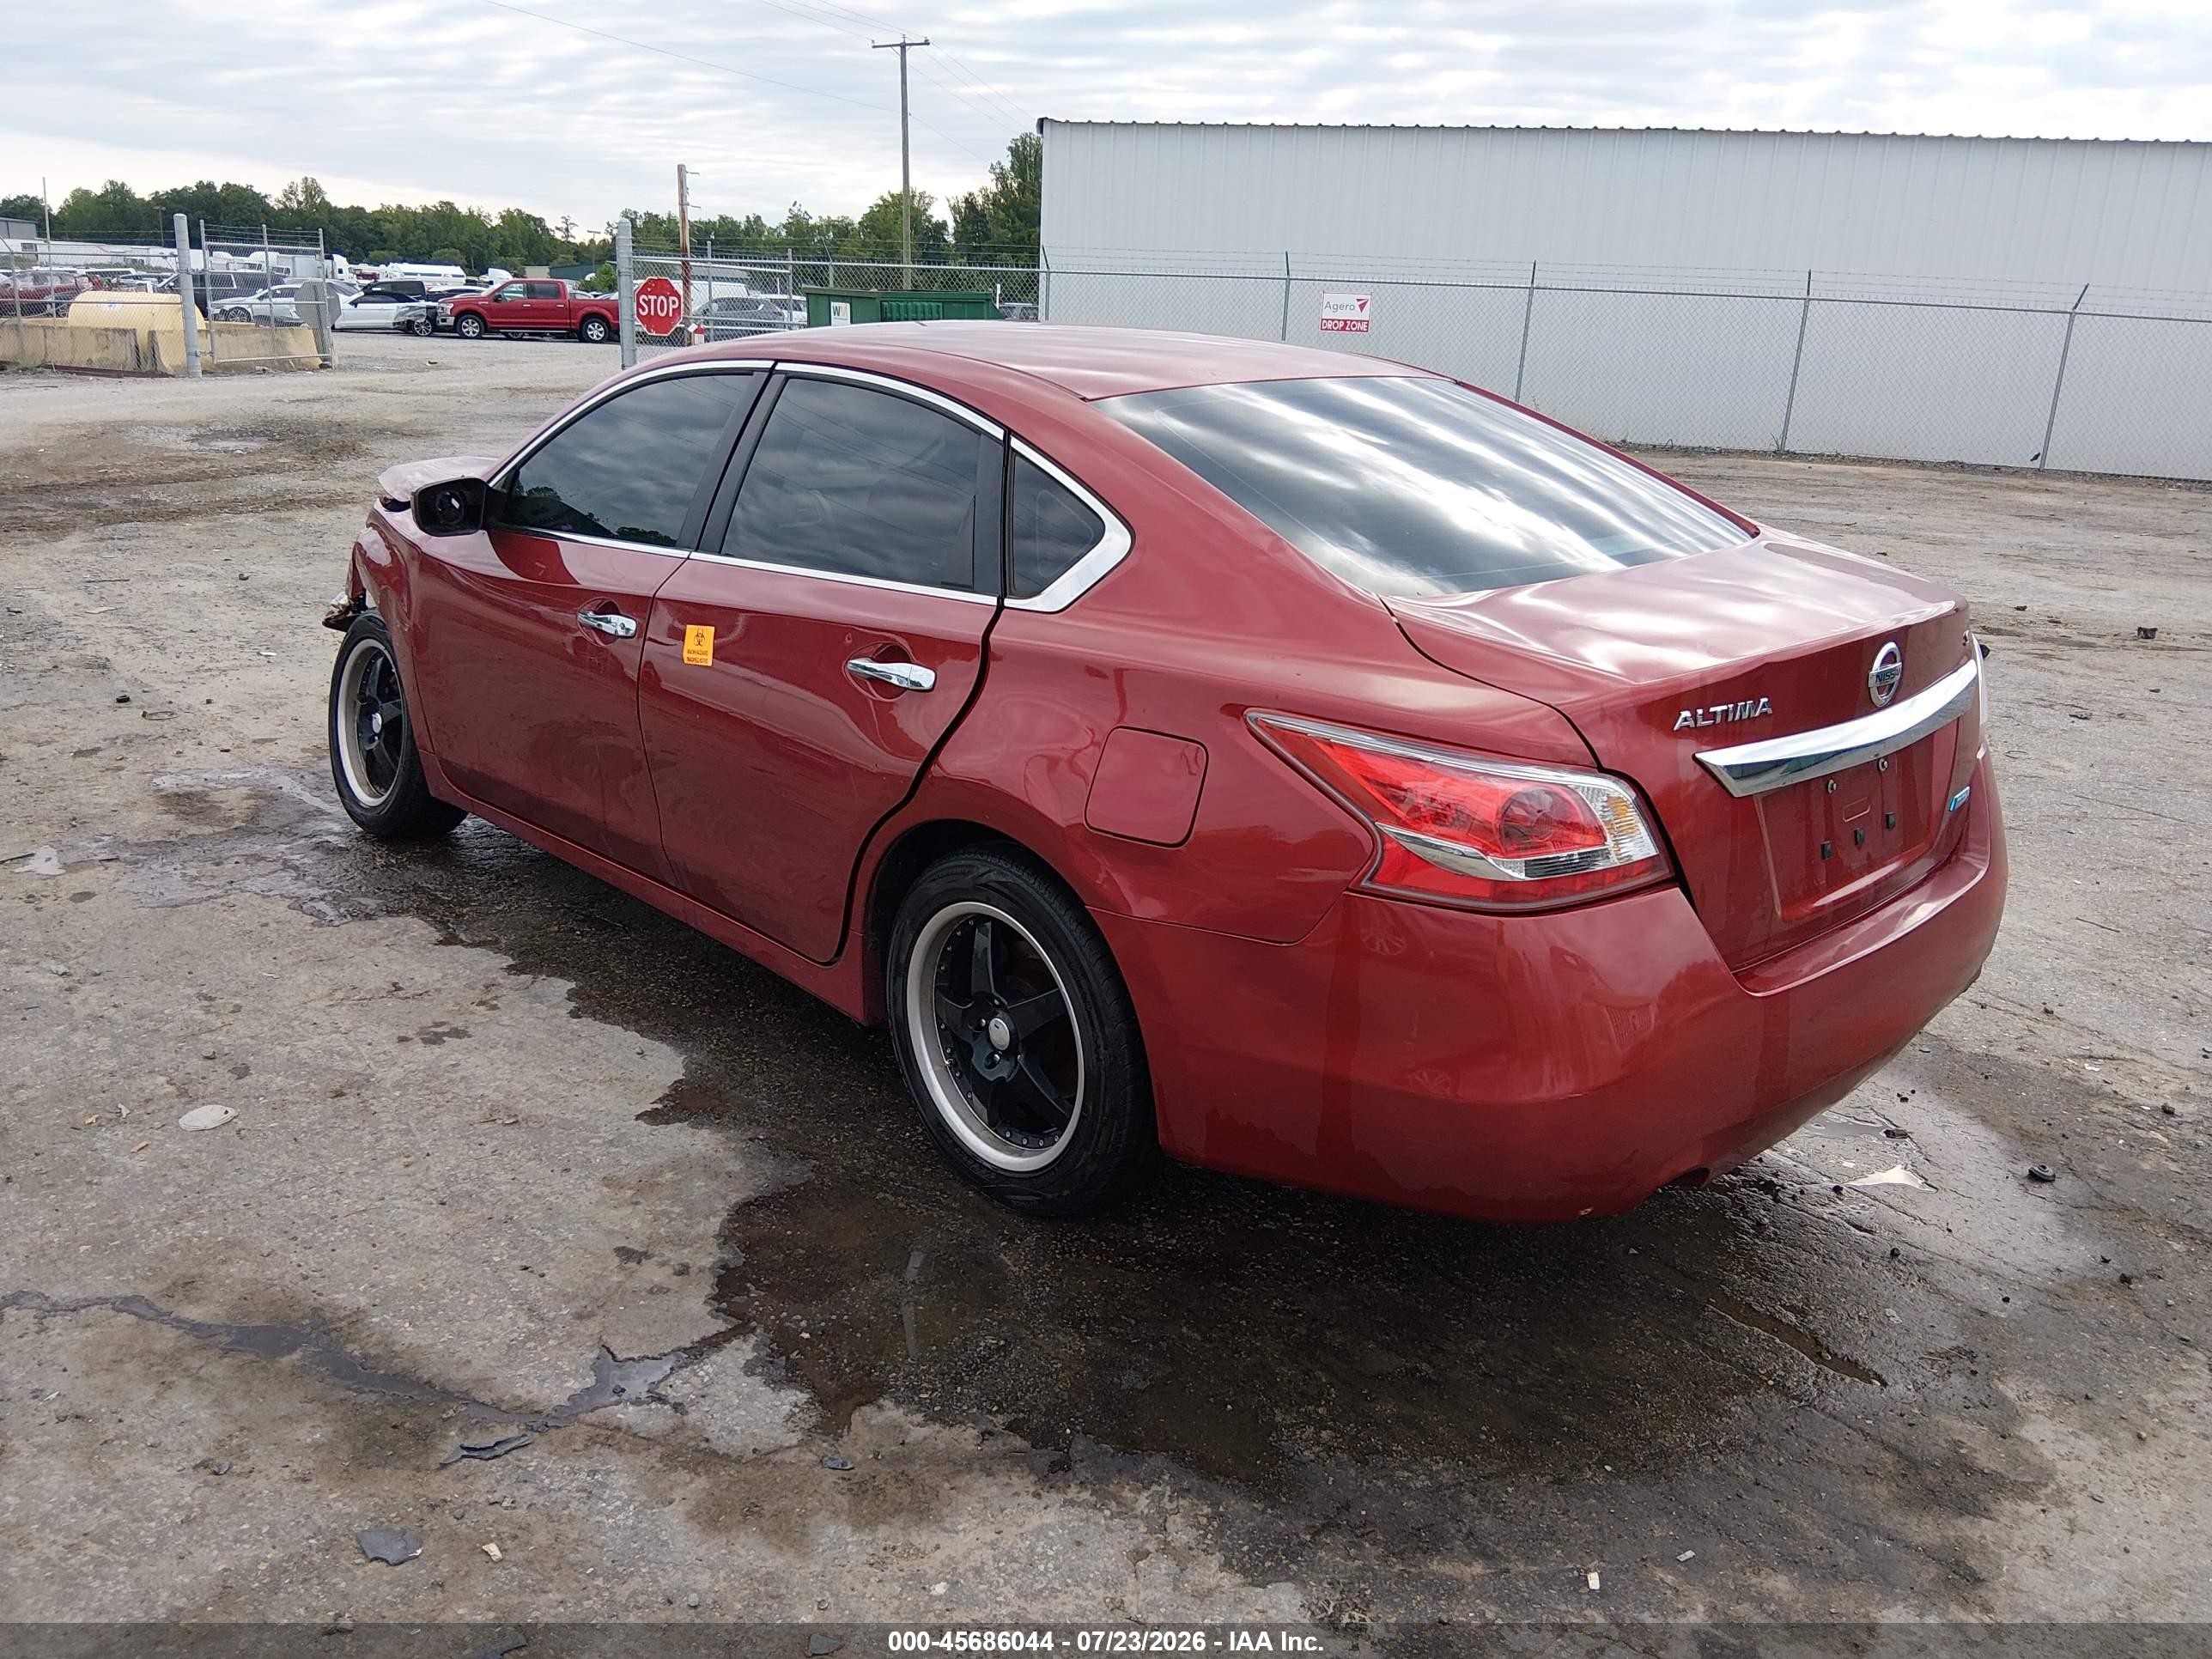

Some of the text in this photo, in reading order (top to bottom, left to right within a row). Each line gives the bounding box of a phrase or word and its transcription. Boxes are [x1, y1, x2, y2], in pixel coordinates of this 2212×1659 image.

[638, 294, 679, 317] STOP
[1324, 301, 1355, 313] Agero
[1322, 319, 1368, 331] DROP ZONE
[1673, 697, 1773, 732] ALTIMA
